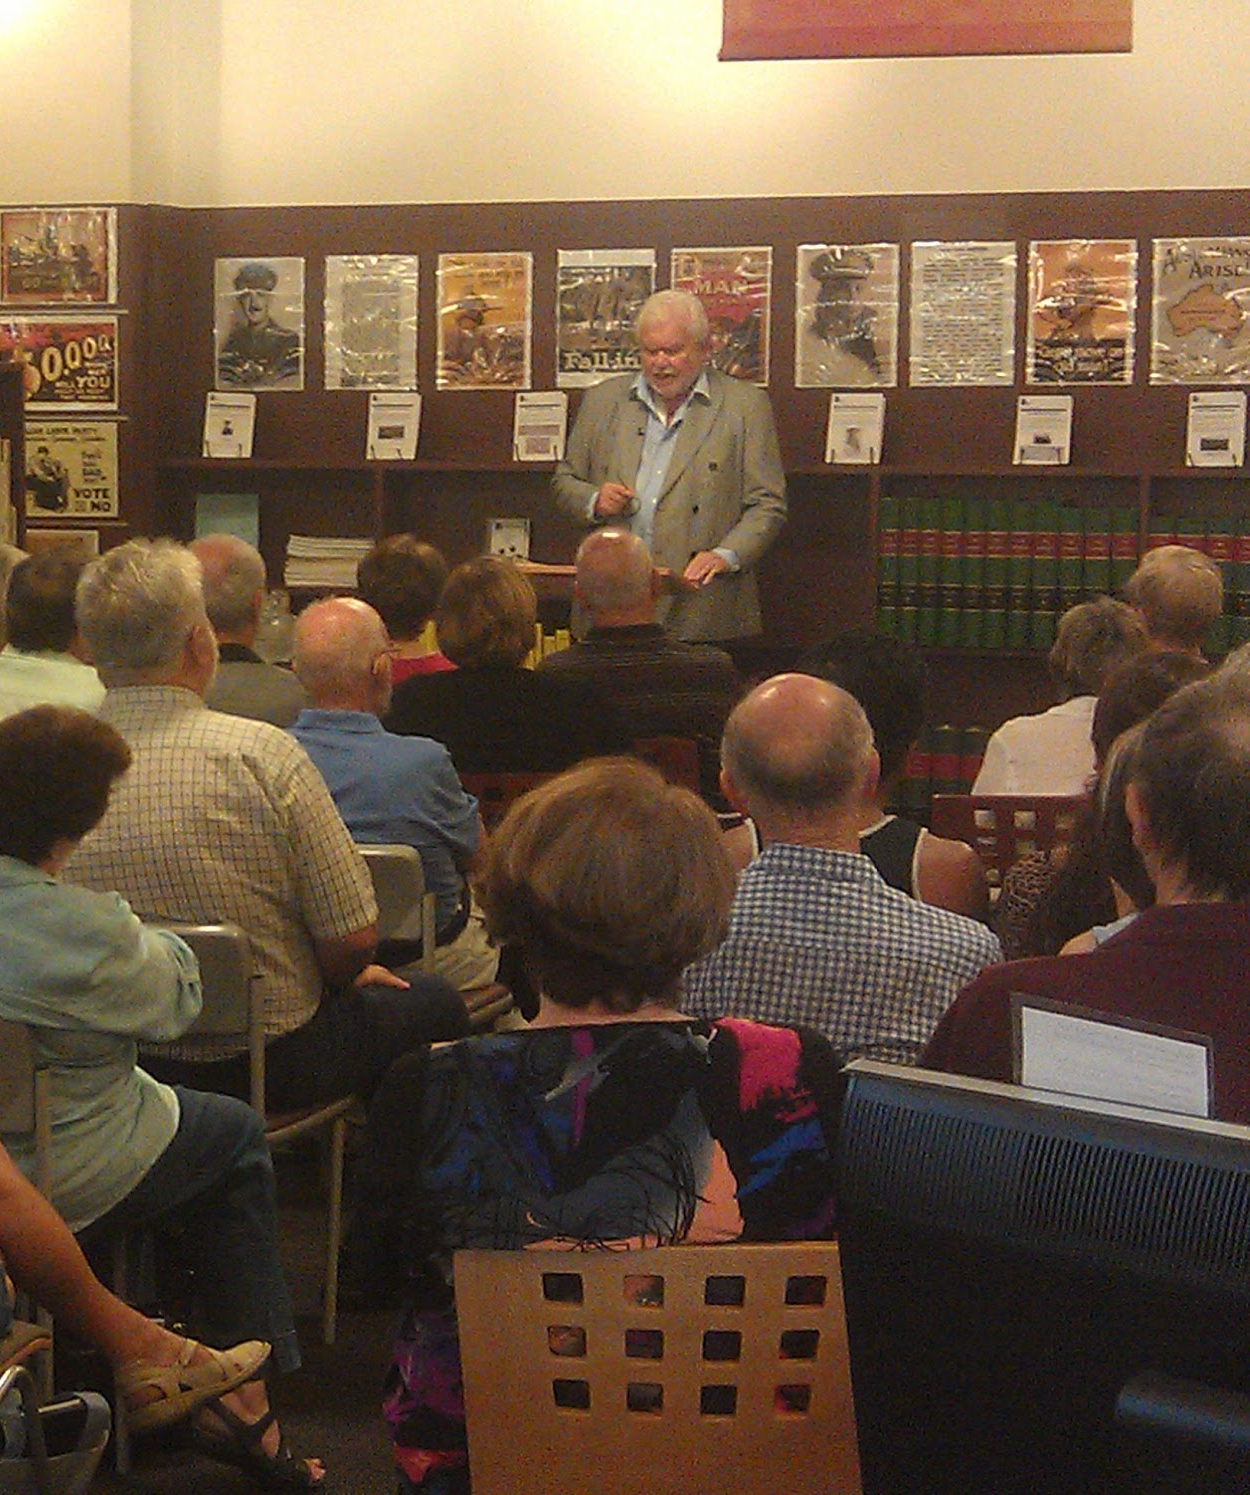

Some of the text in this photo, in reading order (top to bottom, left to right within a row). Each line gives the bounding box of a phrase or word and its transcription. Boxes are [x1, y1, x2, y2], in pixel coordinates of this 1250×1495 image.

[75, 375, 111, 388] YOU
[73, 487, 110, 498] VOTE
[91, 501, 111, 512] NO
